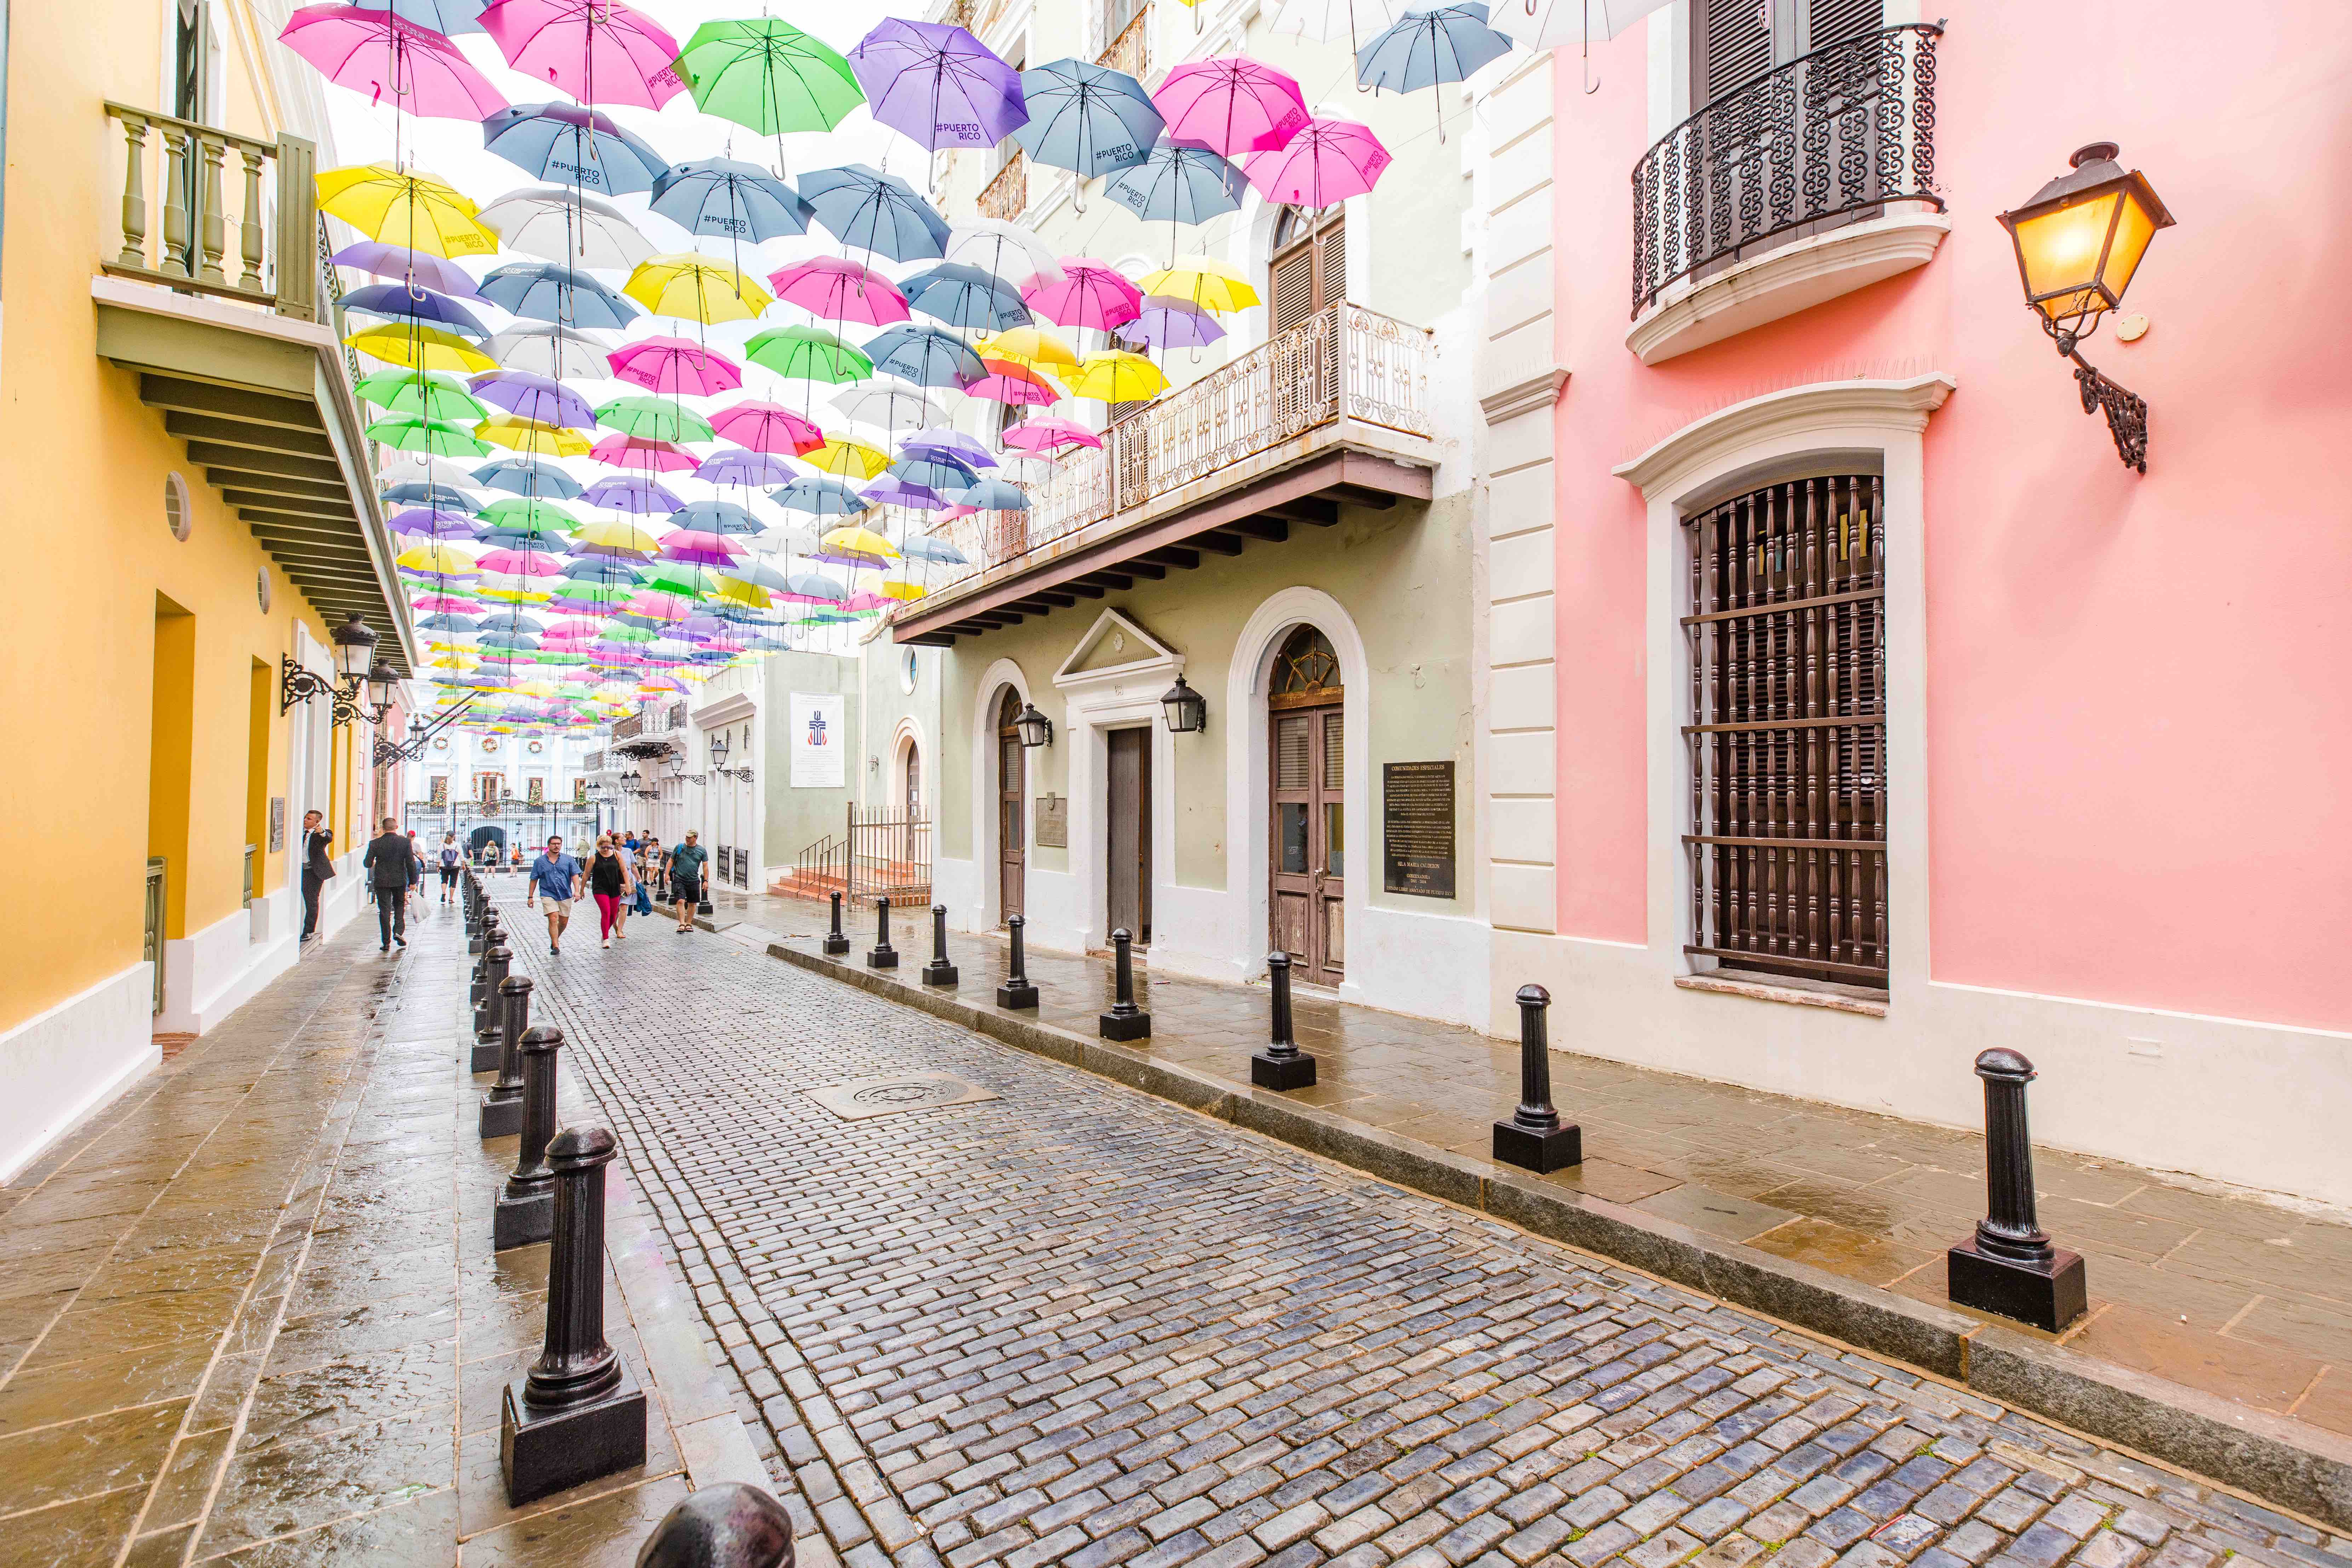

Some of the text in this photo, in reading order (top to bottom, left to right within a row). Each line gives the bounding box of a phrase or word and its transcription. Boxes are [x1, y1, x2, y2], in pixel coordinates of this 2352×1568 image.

[1276, 107, 1298, 131] #PUERTO
[1288, 114, 1301, 129] RICO
[936, 123, 979, 132] #PUERTO
[1096, 143, 1132, 160] #PUERTO
[1115, 151, 1134, 162] RICO
[551, 160, 600, 177] #PUERTO
[1362, 150, 1379, 176] #PUERTO
[1373, 155, 1383, 170] RICO
[576, 173, 600, 184] RICO
[1118, 182, 1146, 202] #PUERTO
[1127, 195, 1142, 208] RICO
[704, 215, 746, 227] #PUERTO
[725, 225, 746, 233] RICO
[445, 234, 480, 244] #PUERTO
[1000, 309, 1022, 320] #PUERTO
[1105, 303, 1129, 316] #PUERTO
[1118, 308, 1132, 317] RICO
[992, 347, 1018, 357] #PUERTO
[889, 359, 918, 373] #PUERTO
[627, 366, 656, 380] #PUERTO
[901, 368, 916, 377] RICO
[638, 376, 653, 385] RICO
